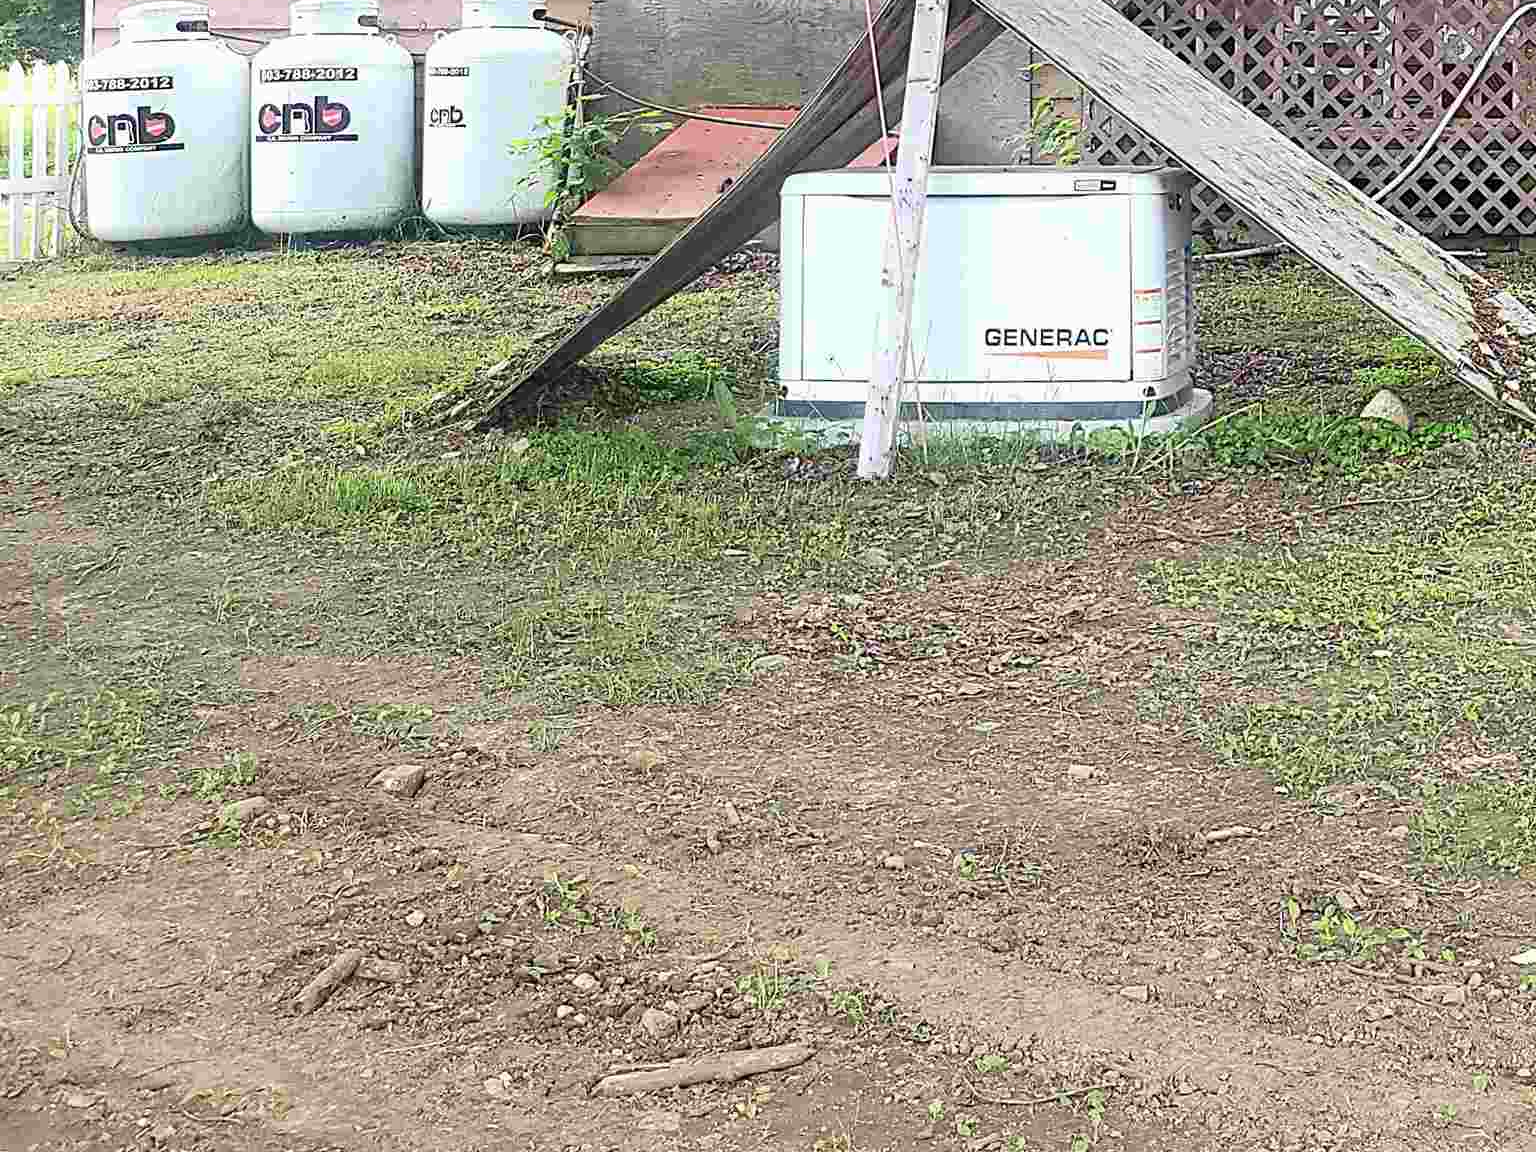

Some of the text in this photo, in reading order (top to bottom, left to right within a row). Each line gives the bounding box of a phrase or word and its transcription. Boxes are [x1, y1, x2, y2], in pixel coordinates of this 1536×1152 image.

[88, 106, 175, 146] cnb
[259, 96, 351, 134] cnb
[430, 105, 464, 124] cnb
[984, 328, 1109, 346] GENERAC
